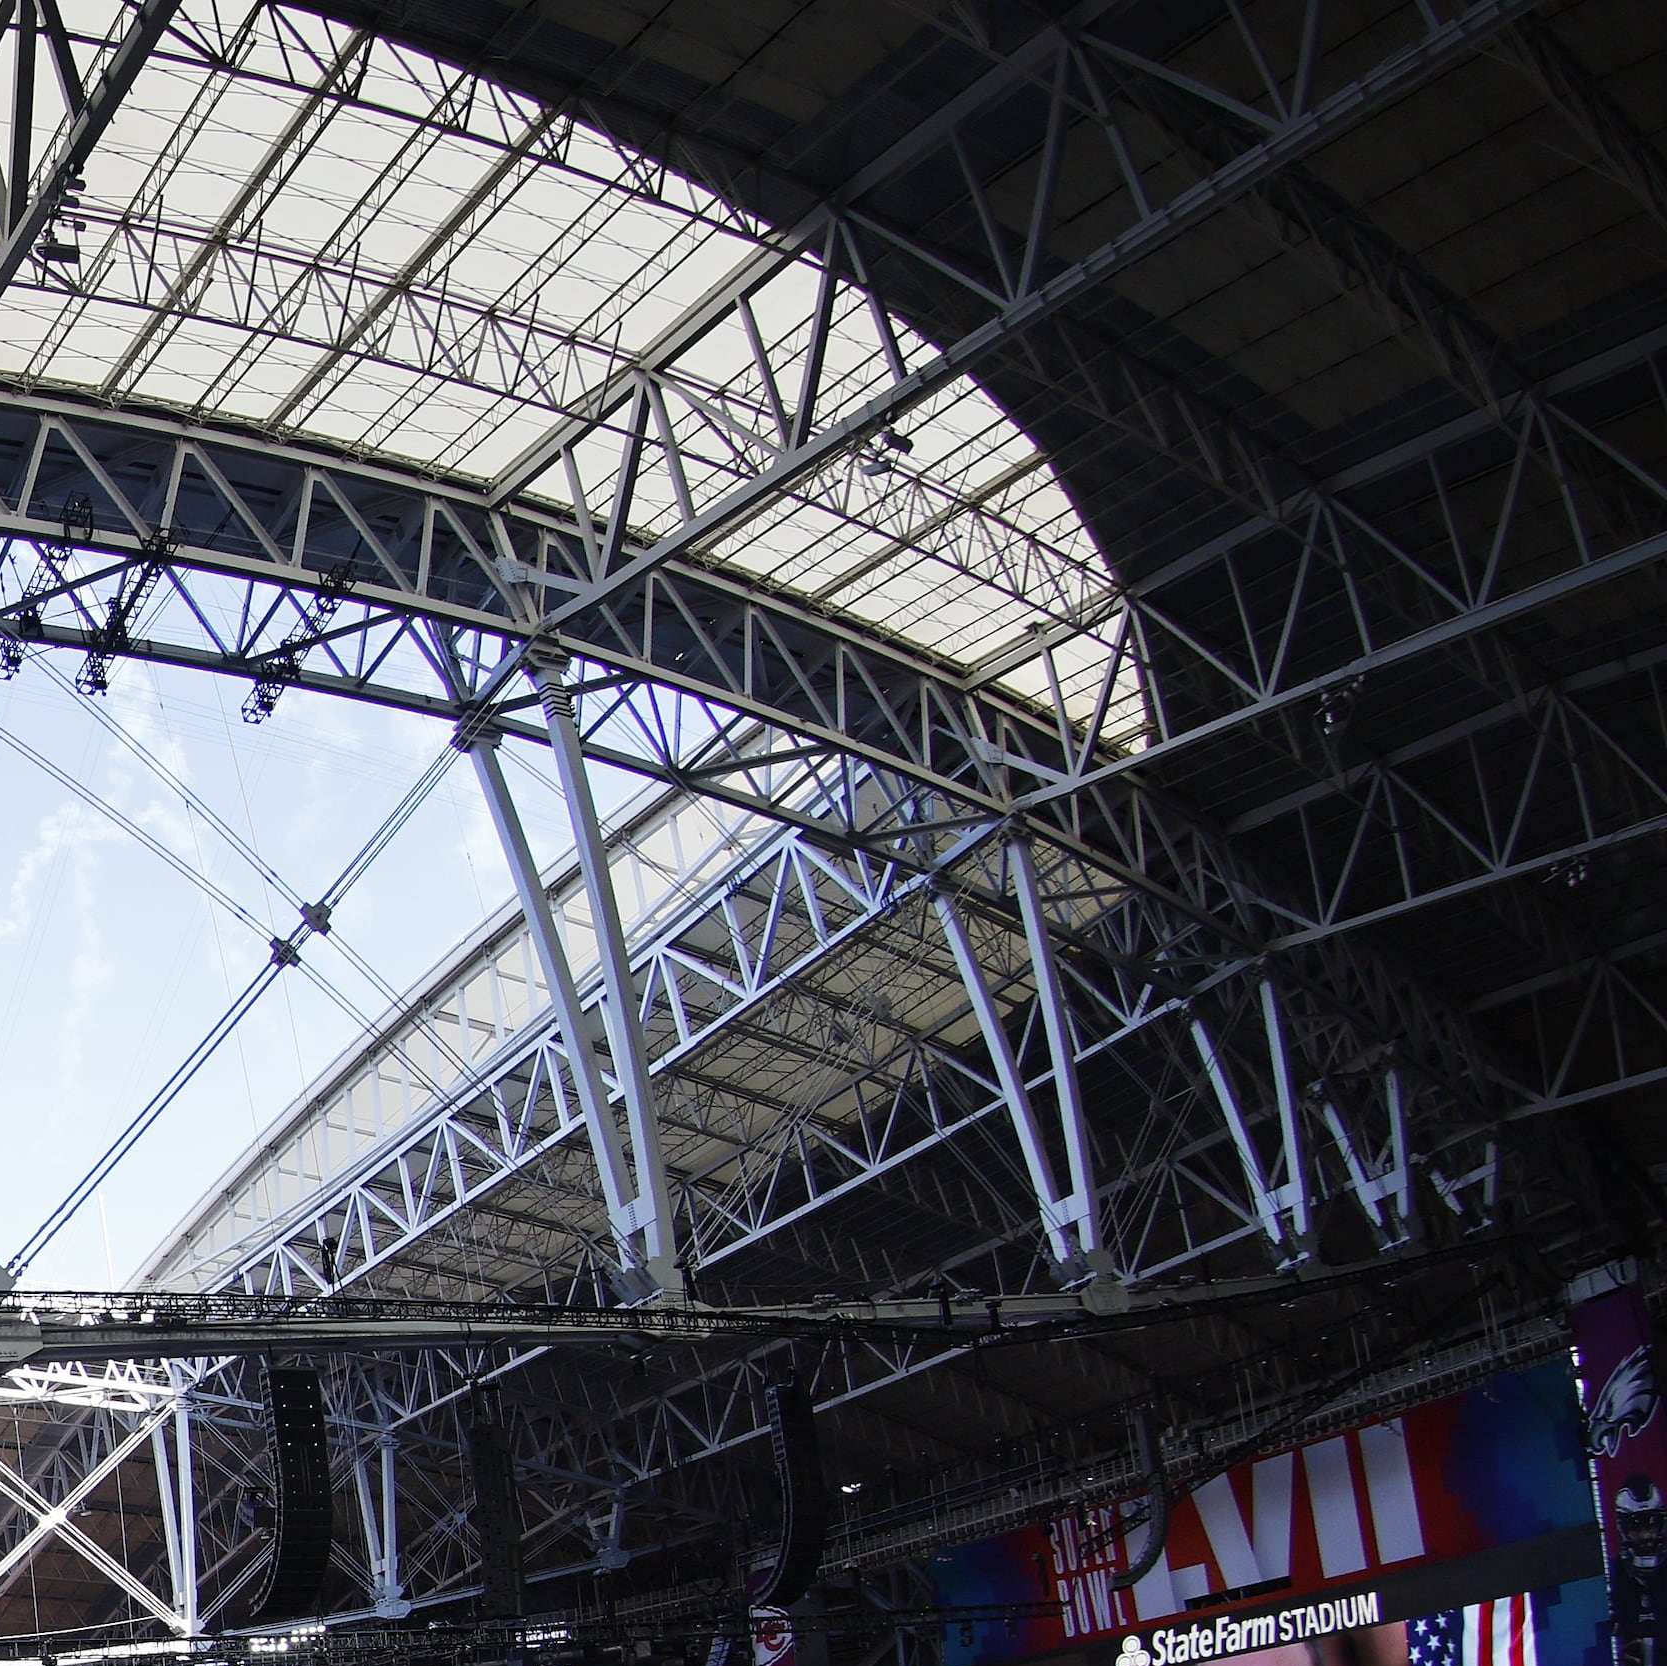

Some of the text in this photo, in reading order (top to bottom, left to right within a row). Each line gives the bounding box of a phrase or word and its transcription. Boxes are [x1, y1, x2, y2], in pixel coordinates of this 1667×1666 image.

[1123, 1417, 1426, 1621] LVII
[1057, 1567, 1128, 1638] BOWL
[1278, 1591, 1380, 1642] STADIUM
